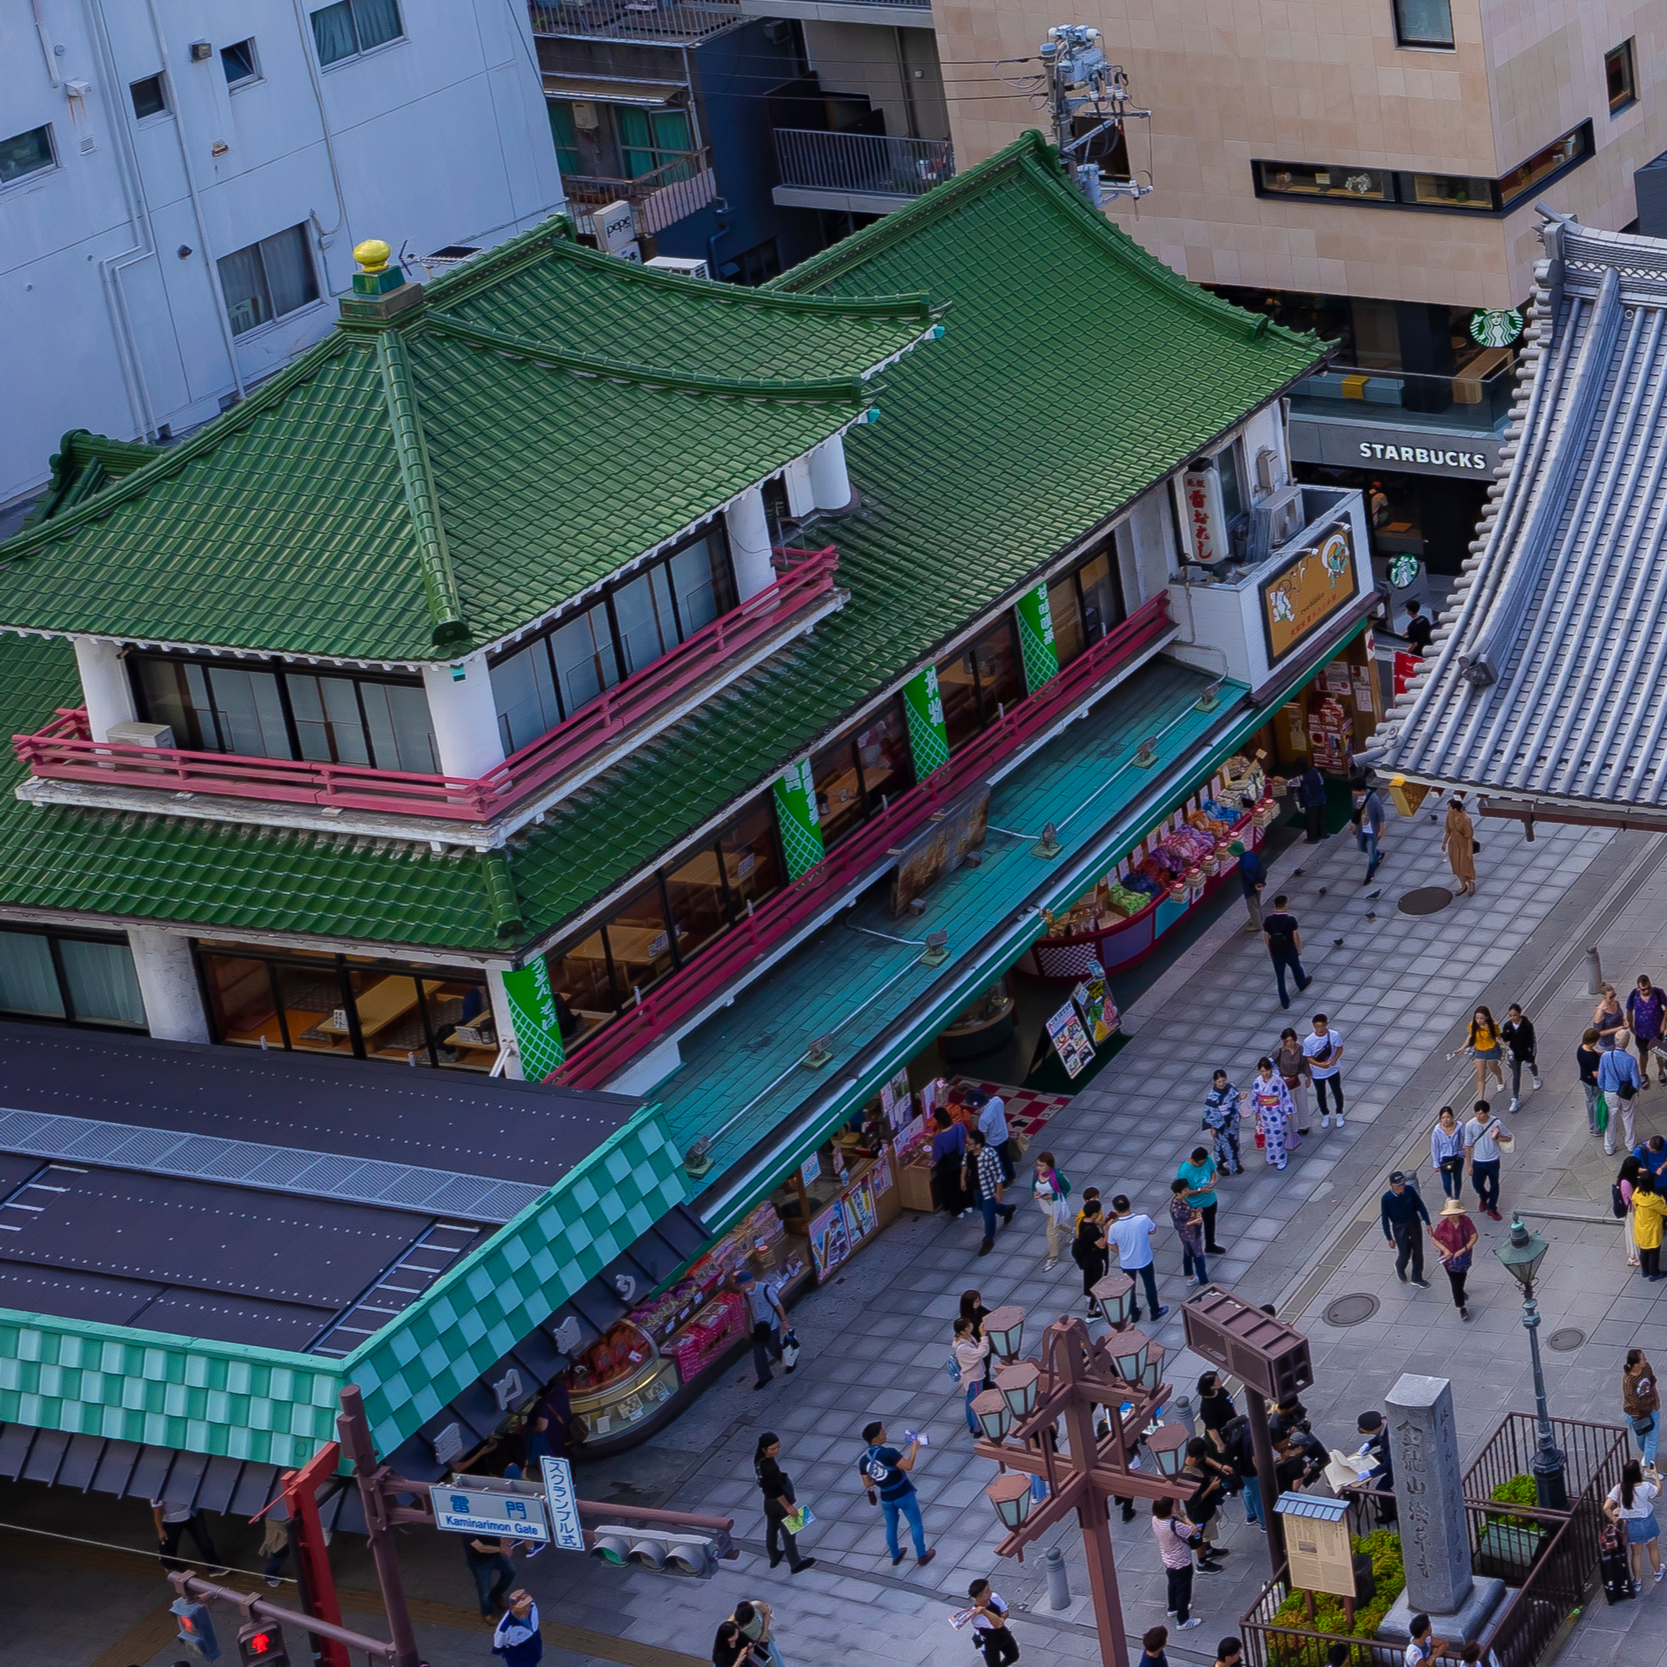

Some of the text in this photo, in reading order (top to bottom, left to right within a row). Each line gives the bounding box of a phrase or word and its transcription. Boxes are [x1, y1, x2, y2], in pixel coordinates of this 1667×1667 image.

[1359, 442, 1488, 470] STARBUCKS
[450, 1494, 528, 1521] 雷門
[549, 1461, 578, 1546] スクランブル式
[445, 1514, 539, 1536] Kaminarimon Gate
